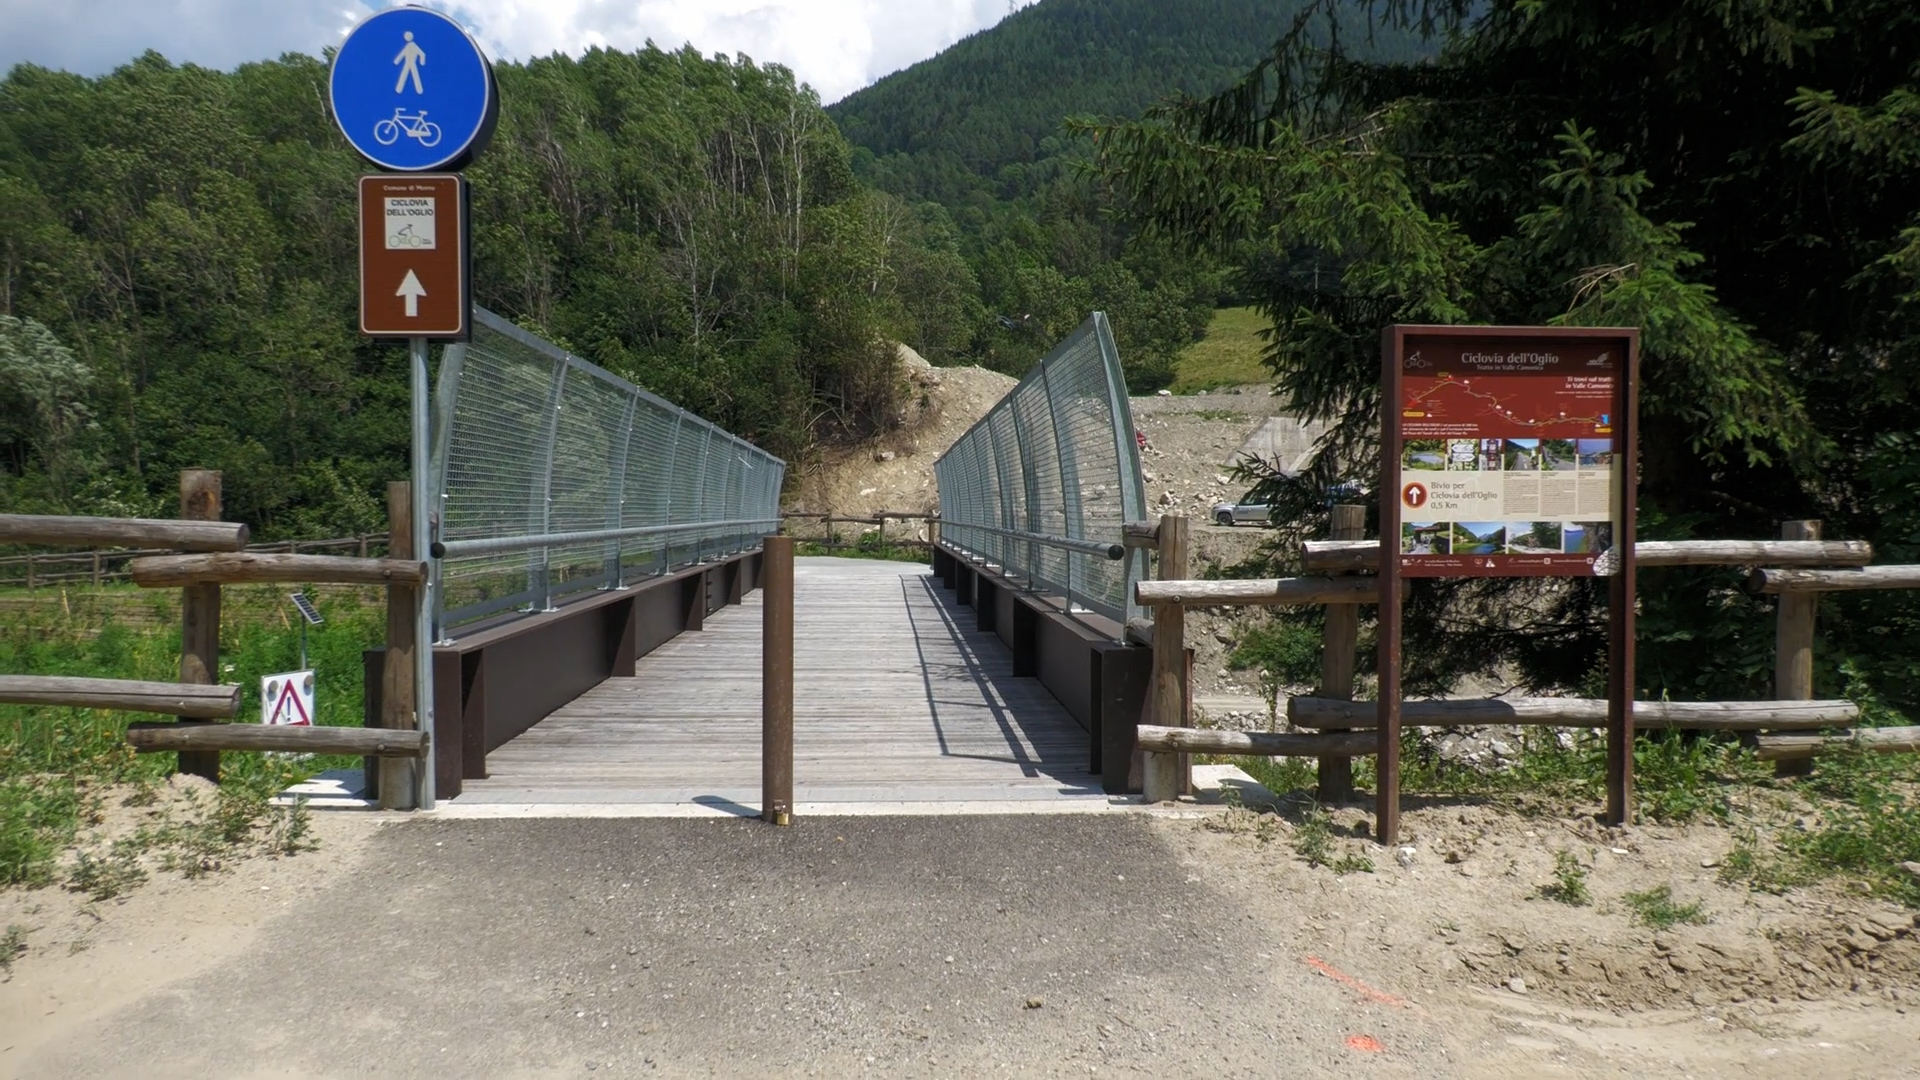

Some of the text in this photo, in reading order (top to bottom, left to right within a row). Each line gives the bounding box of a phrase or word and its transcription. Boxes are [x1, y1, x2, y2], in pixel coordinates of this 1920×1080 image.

[1461, 352, 1559, 365] Ciclovia dell'Oglio
[1431, 481, 1465, 491] Bivio per
[1431, 491, 1498, 500] Ciclovia dell'Oglio
[1431, 502, 1443, 510] 0,5
